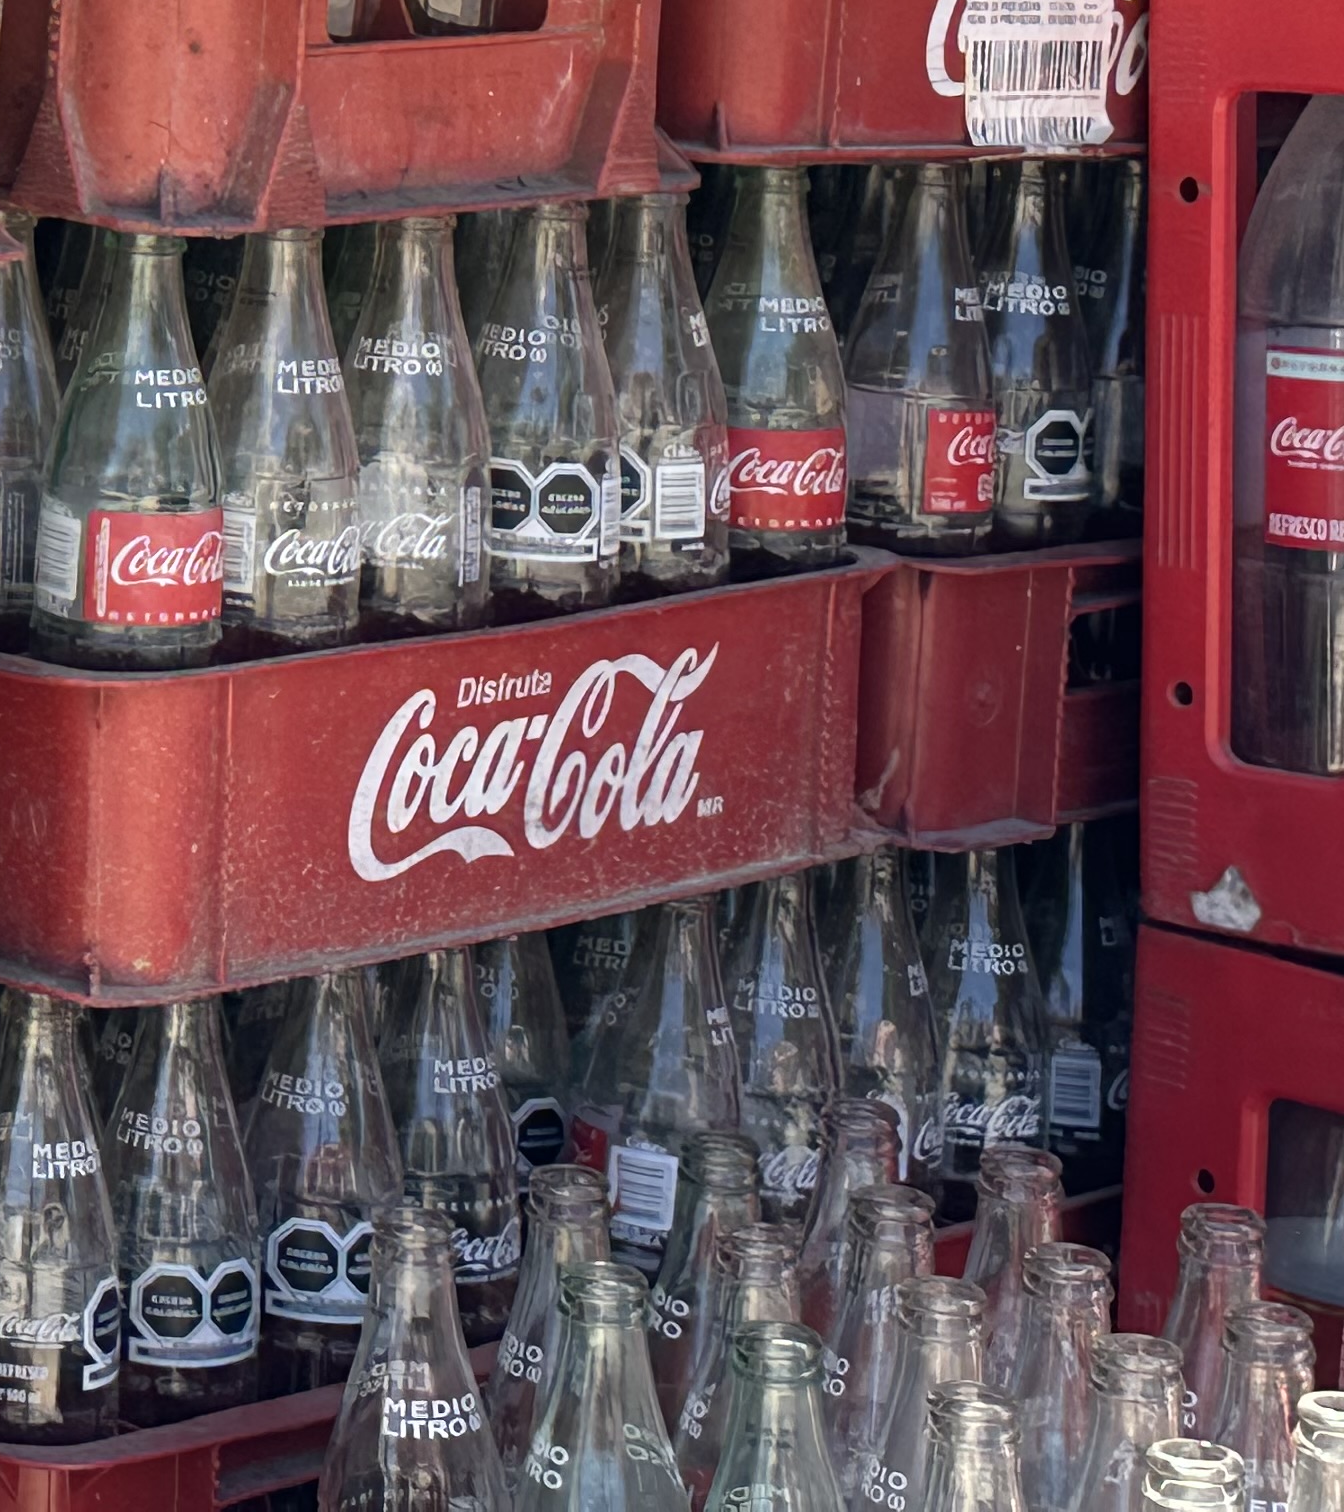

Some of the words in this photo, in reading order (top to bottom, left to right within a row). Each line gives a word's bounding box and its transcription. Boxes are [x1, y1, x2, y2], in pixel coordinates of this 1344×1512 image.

[456, 668, 553, 709] Disfruta
[347, 640, 720, 883] Coca-Cola
[382, 1392, 477, 1422] MEDIO
[381, 1416, 467, 1441] LITRO
